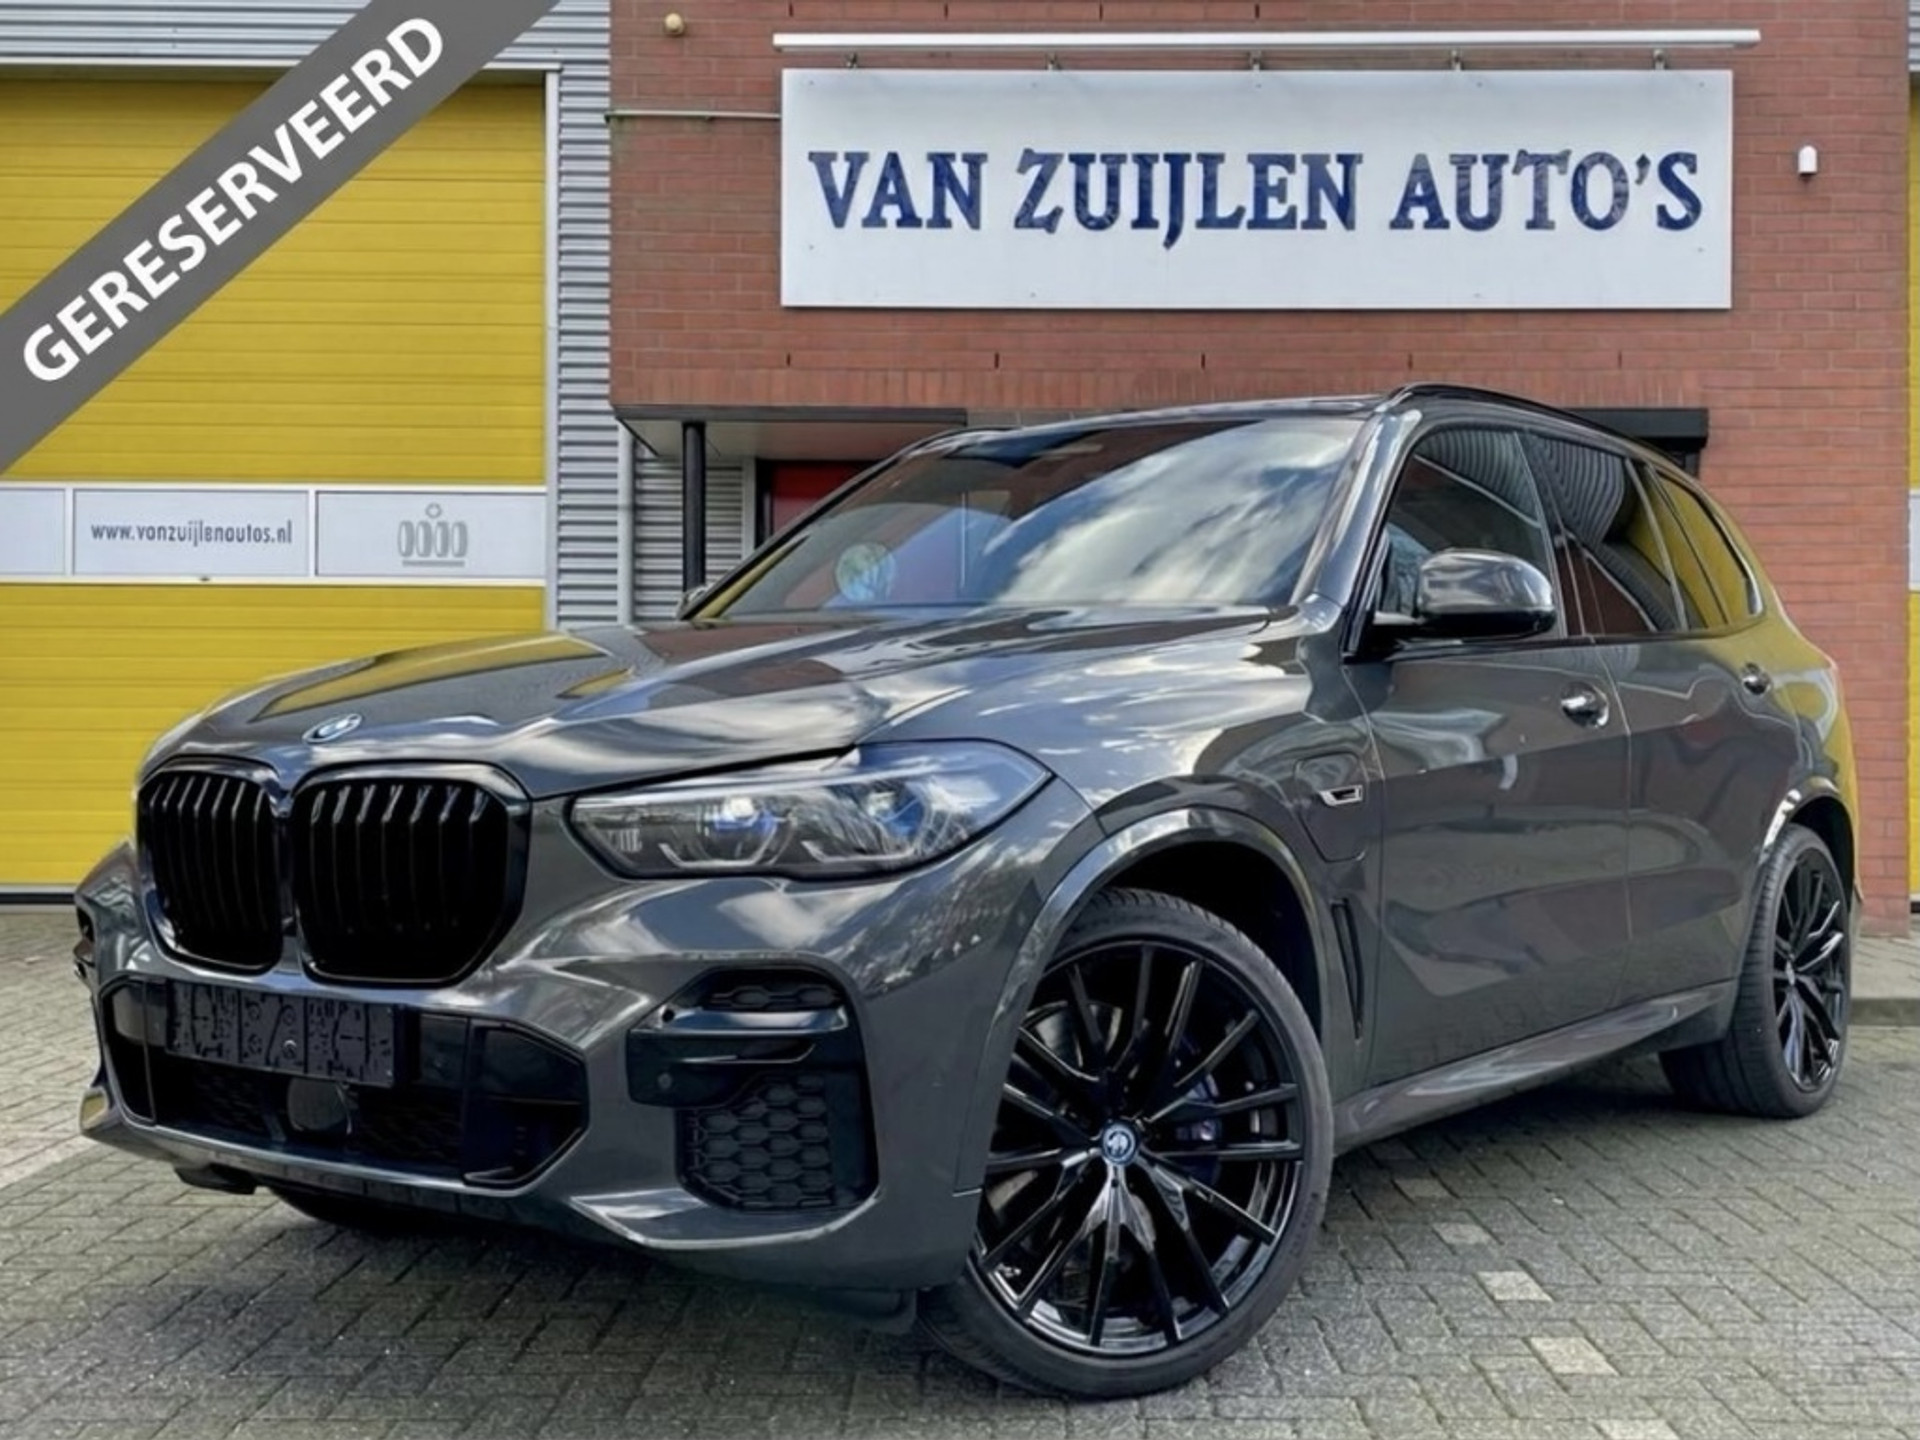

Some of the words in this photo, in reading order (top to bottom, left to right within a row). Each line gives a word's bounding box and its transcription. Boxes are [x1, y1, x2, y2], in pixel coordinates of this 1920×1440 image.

[808, 151, 988, 231] VAN
[1013, 148, 1363, 249] ZUIJLEN
[1389, 149, 1702, 232] AUTO'S
[91, 520, 292, 547] www.vanzuijlenautos.nl
